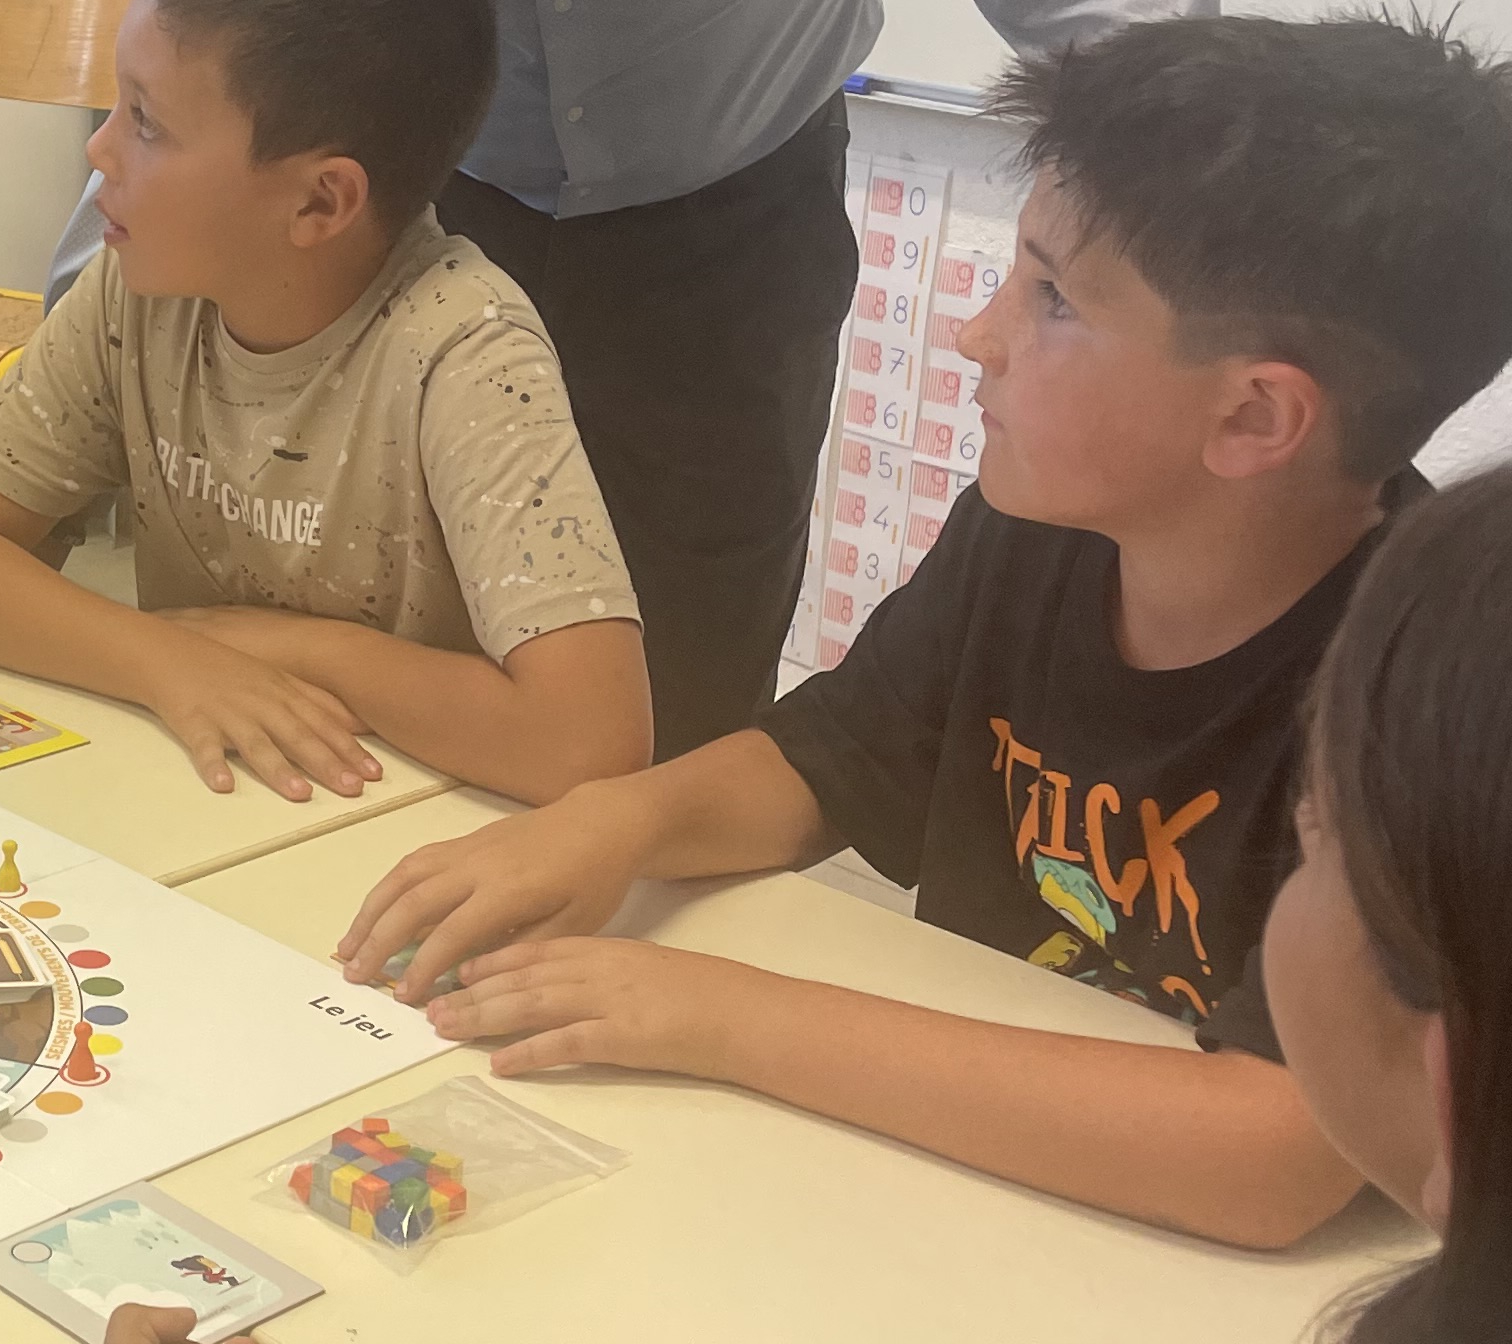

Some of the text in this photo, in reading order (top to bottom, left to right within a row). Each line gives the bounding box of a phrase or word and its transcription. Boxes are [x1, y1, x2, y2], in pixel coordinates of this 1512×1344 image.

[221, 482, 324, 547] CHANGE
[26, 934, 46, 947] DE
[37, 946, 75, 1012] MOUVEMENTS
[308, 995, 395, 1041] Le jeu
